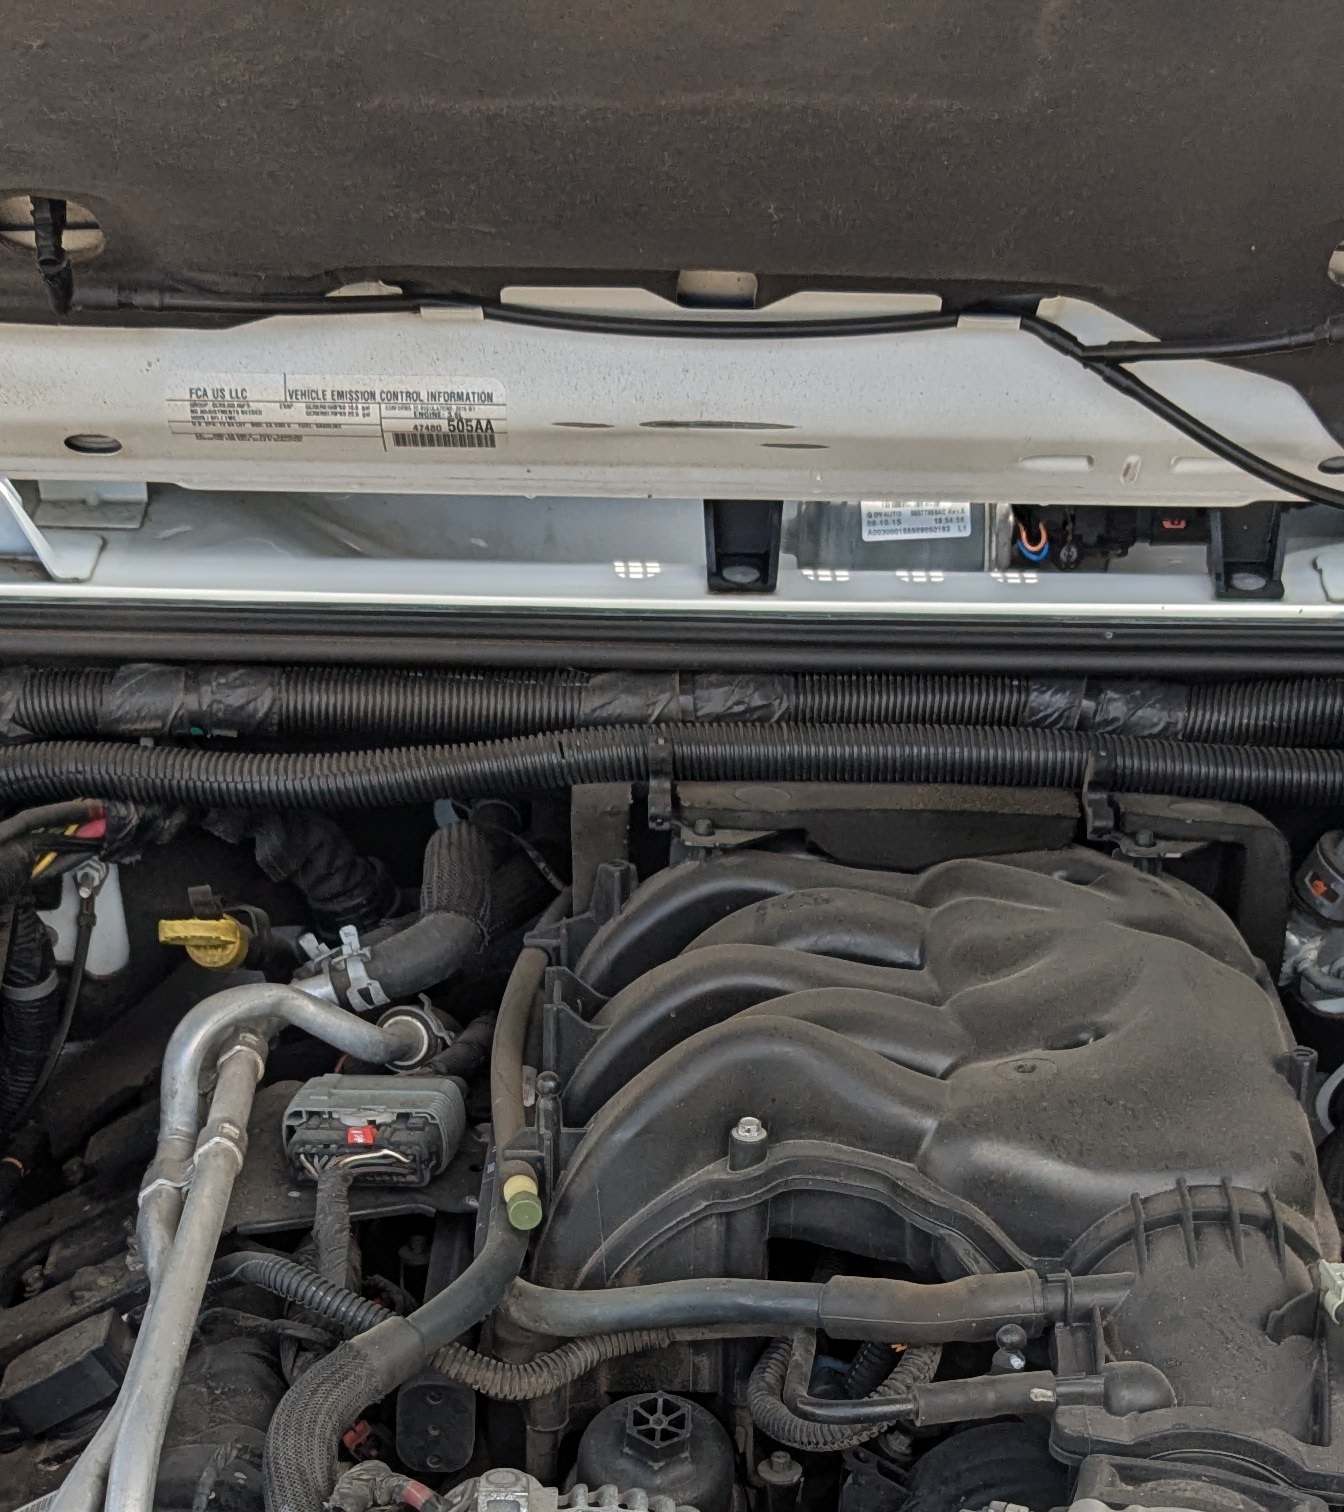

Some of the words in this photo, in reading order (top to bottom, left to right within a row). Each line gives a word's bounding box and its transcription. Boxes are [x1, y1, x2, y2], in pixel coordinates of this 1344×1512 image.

[188, 387, 208, 400] FCA
[212, 387, 226, 400] US
[229, 388, 248, 400] LLC
[287, 388, 327, 401] VEHICLE
[330, 389, 376, 402] EMISSION
[379, 390, 424, 402] CONTROL
[426, 391, 494, 404] INFORMATION
[447, 419, 495, 433] 505AA
